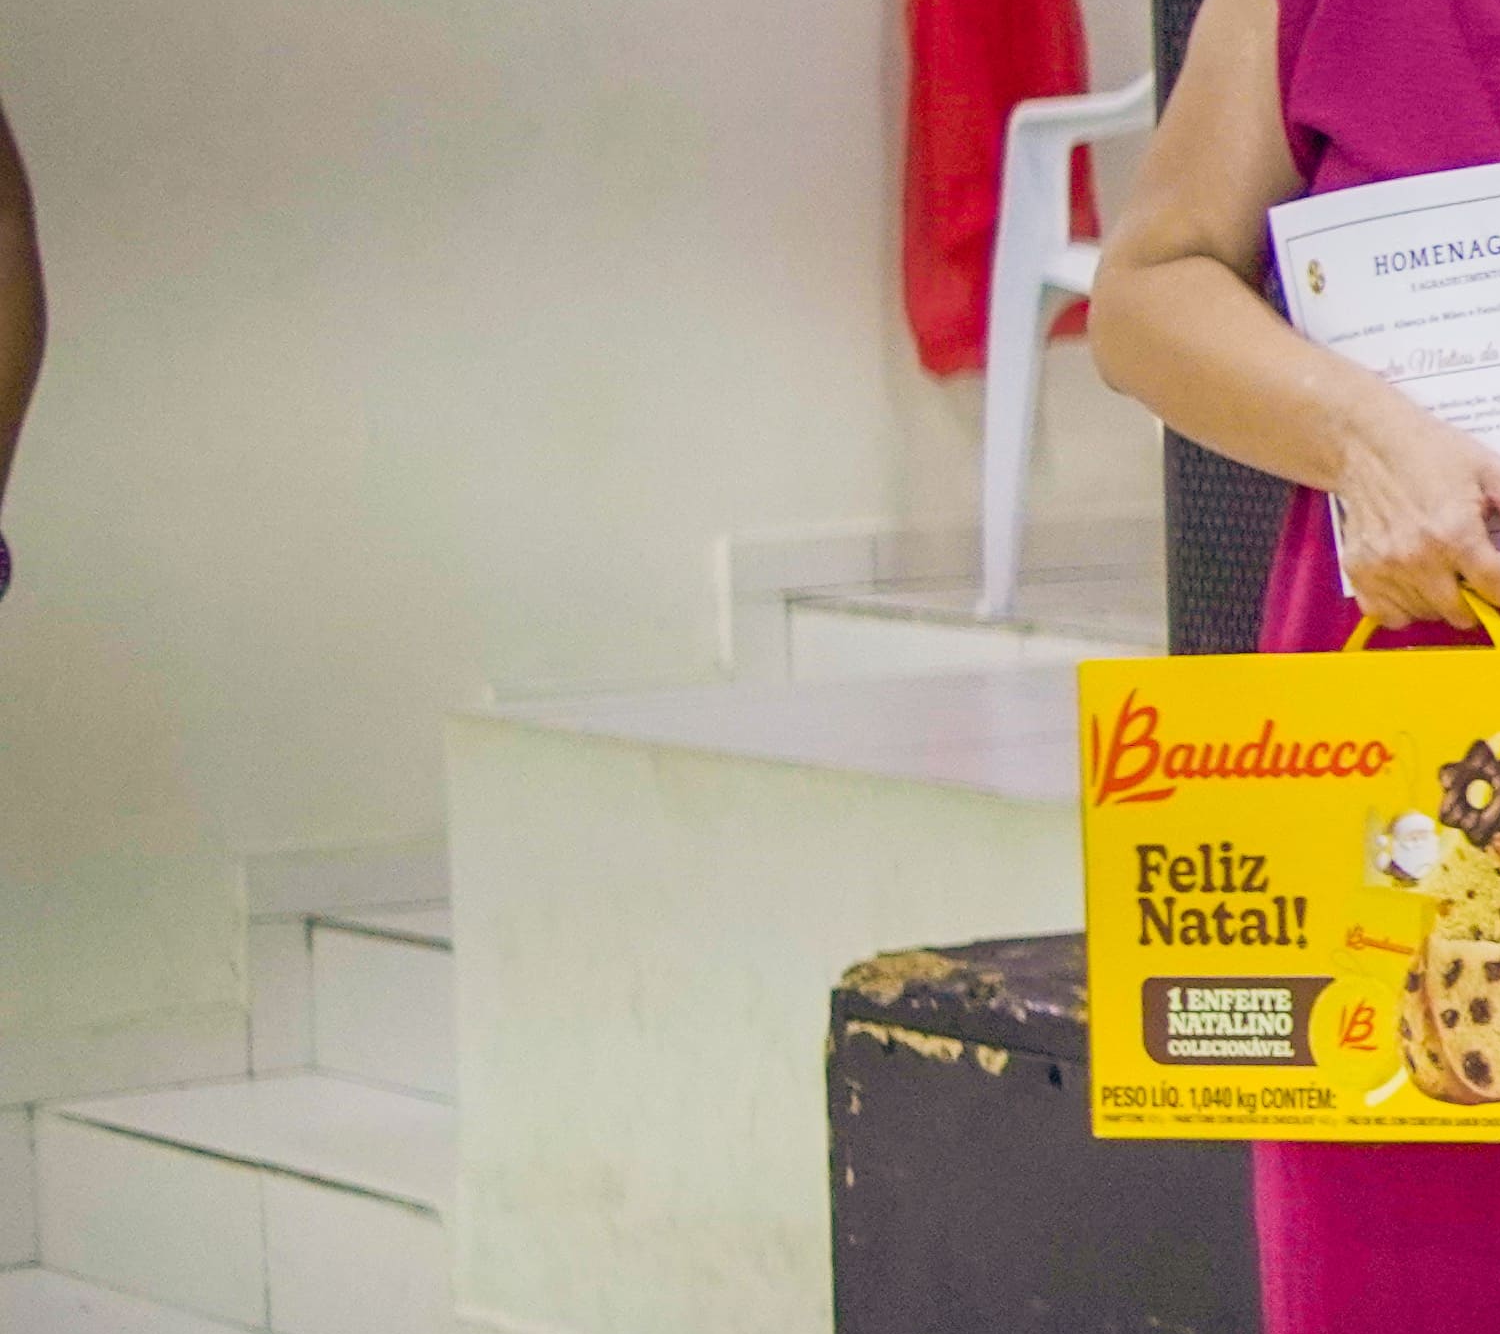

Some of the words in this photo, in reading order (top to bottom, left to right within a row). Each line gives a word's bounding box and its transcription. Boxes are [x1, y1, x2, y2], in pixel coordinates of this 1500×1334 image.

[1091, 687, 1395, 807] Bauducco
[1135, 840, 1270, 894] Feliz
[1137, 895, 1308, 949] Natal!
[1166, 986, 1183, 1013] 1
[1185, 987, 1293, 1013] ENFEITE
[1167, 1012, 1294, 1037] NATALINO
[1167, 1037, 1296, 1058] COLECIONÁVEL
[1102, 1085, 1148, 1109] PESO
[1150, 1080, 1184, 1109] LÍQ.
[1189, 1085, 1234, 1112] 1,040
[1236, 1085, 1258, 1115] kg
[1260, 1080, 1338, 1110] CONTÉM:
